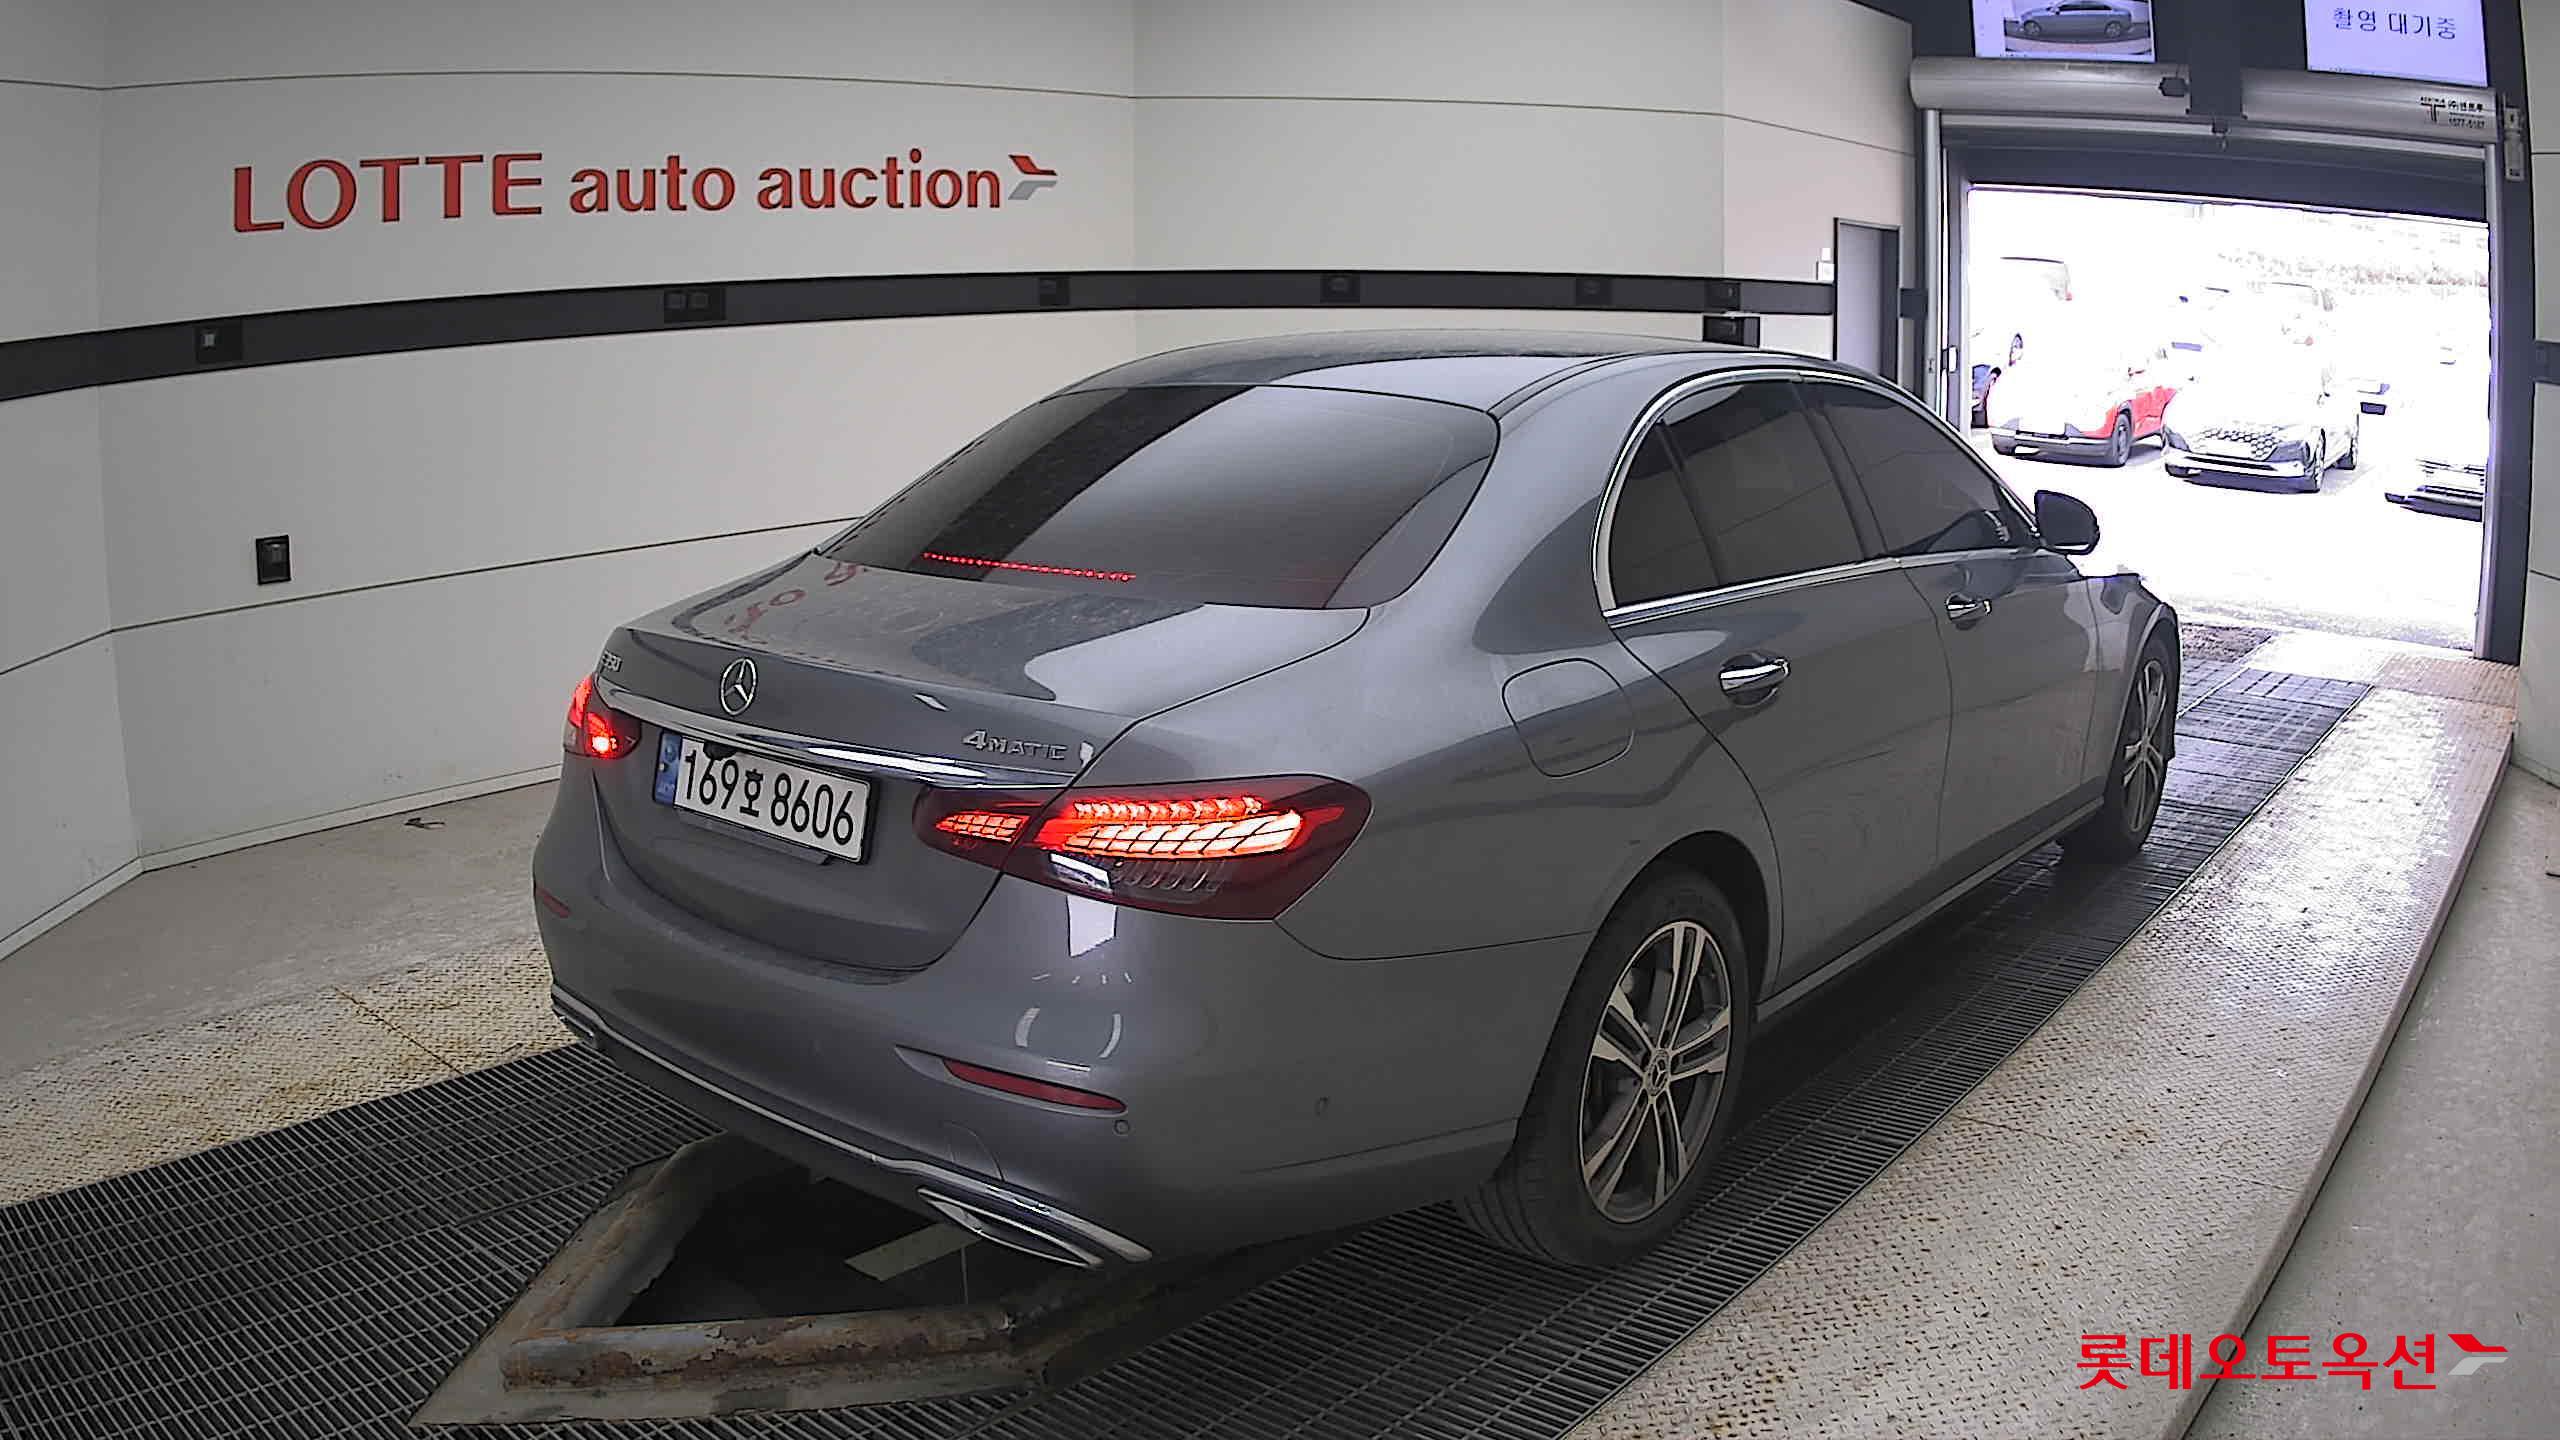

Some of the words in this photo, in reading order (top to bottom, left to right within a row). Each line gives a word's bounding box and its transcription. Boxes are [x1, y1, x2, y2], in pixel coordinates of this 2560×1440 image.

[2388, 13, 2457, 40] 대기중
[233, 152, 543, 233] LOTTE
[569, 154, 736, 214] auto
[757, 147, 1002, 210] auction
[961, 729, 1068, 760] 4MATIC
[684, 749, 763, 817] 169호
[770, 772, 854, 845] 8606
